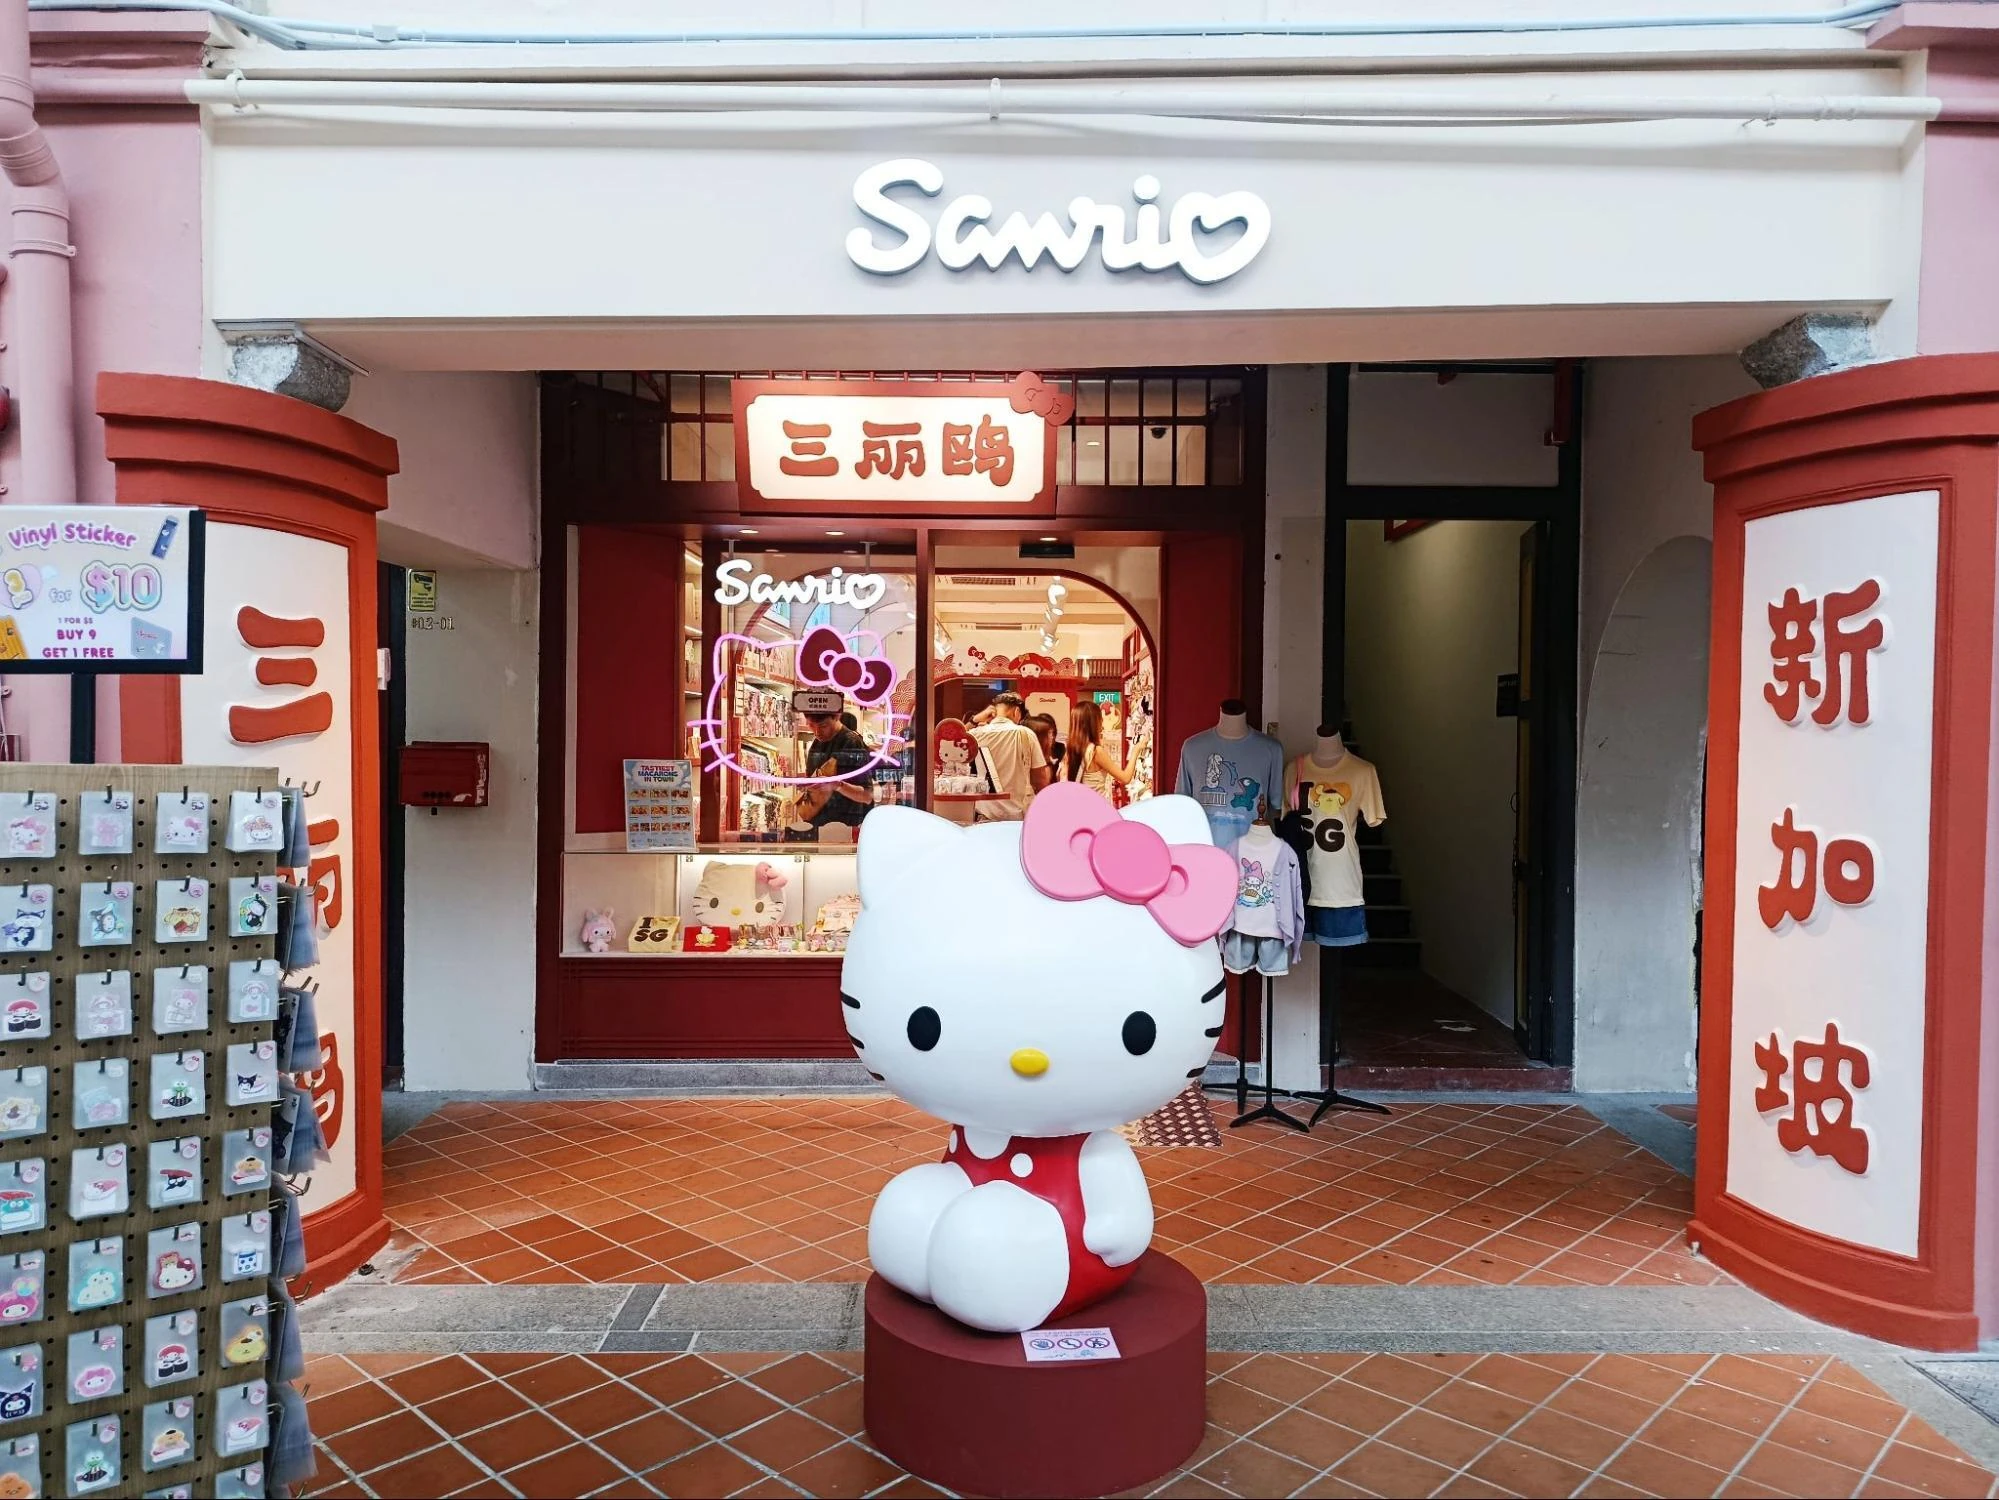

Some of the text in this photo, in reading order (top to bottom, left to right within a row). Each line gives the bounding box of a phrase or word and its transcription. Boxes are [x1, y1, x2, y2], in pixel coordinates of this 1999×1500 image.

[846, 158, 1271, 284] Sanrio
[779, 414, 1014, 487] 三丽鸥
[9, 522, 138, 549] Vinyl Sticker
[49, 588, 72, 604] for
[82, 562, 159, 611] $10
[714, 559, 886, 609] Sanrio
[42, 647, 115, 658] GET 1 FREE
[57, 629, 97, 640] BUY 9
[1099, 693, 1116, 702] EXIT
[1755, 578, 1883, 1175] 新加坡
[634, 929, 668, 942] SG
